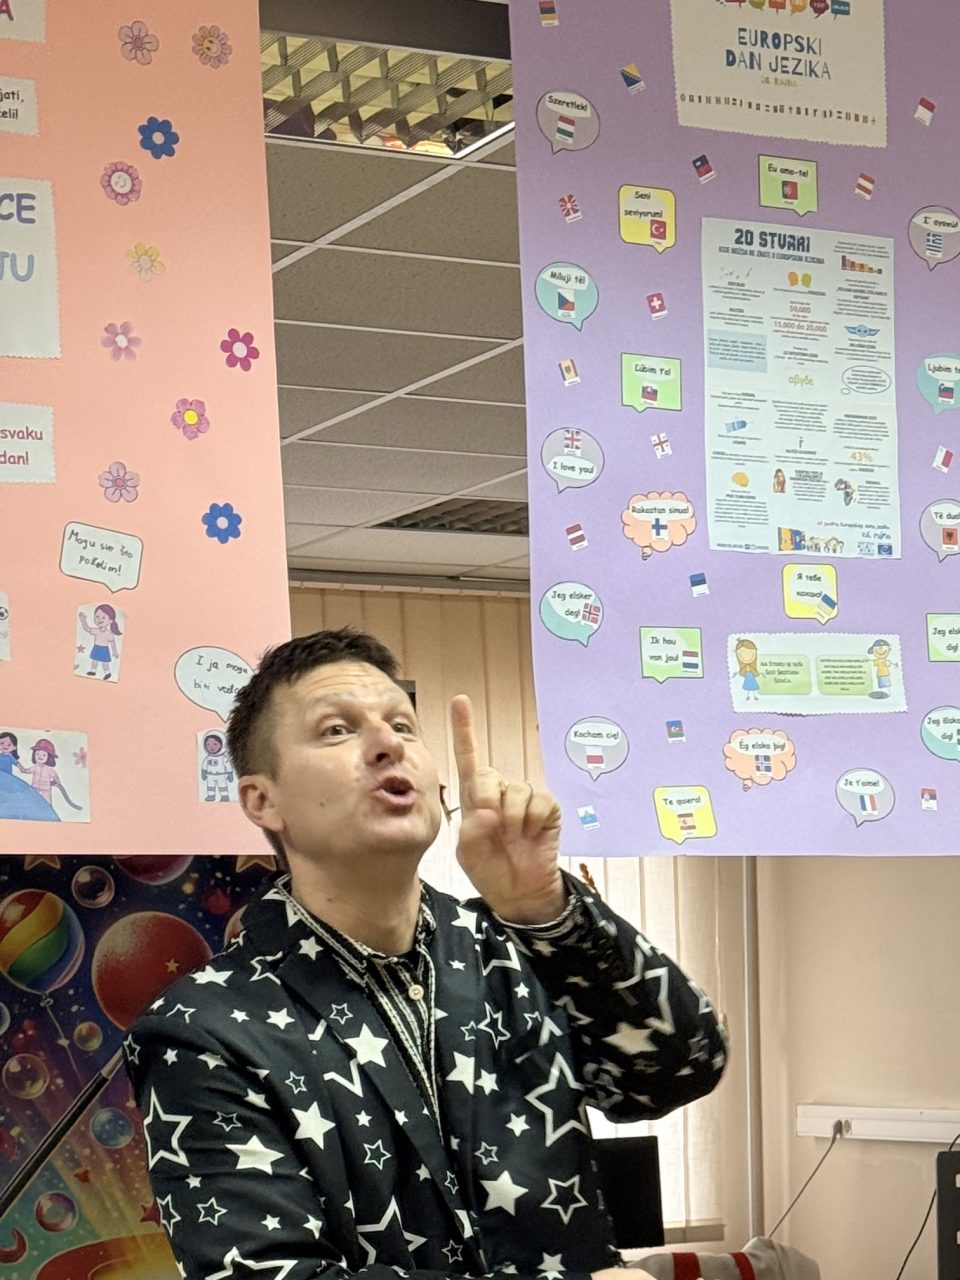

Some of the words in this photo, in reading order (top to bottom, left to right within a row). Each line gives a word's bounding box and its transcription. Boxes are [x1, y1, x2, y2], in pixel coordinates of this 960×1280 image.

[738, 27, 822, 56] EUROPSKI
[726, 49, 762, 71] DAN
[769, 55, 832, 80] JEZIKA
[0, 107, 19, 120] eli!
[767, 163, 778, 174] Eu
[635, 190, 651, 200] Seni
[734, 228, 754, 247] 20
[550, 271, 572, 285] Miluji
[0, 426, 43, 441] svaku
[560, 462, 576, 473] love
[68, 529, 96, 550] Mogu
